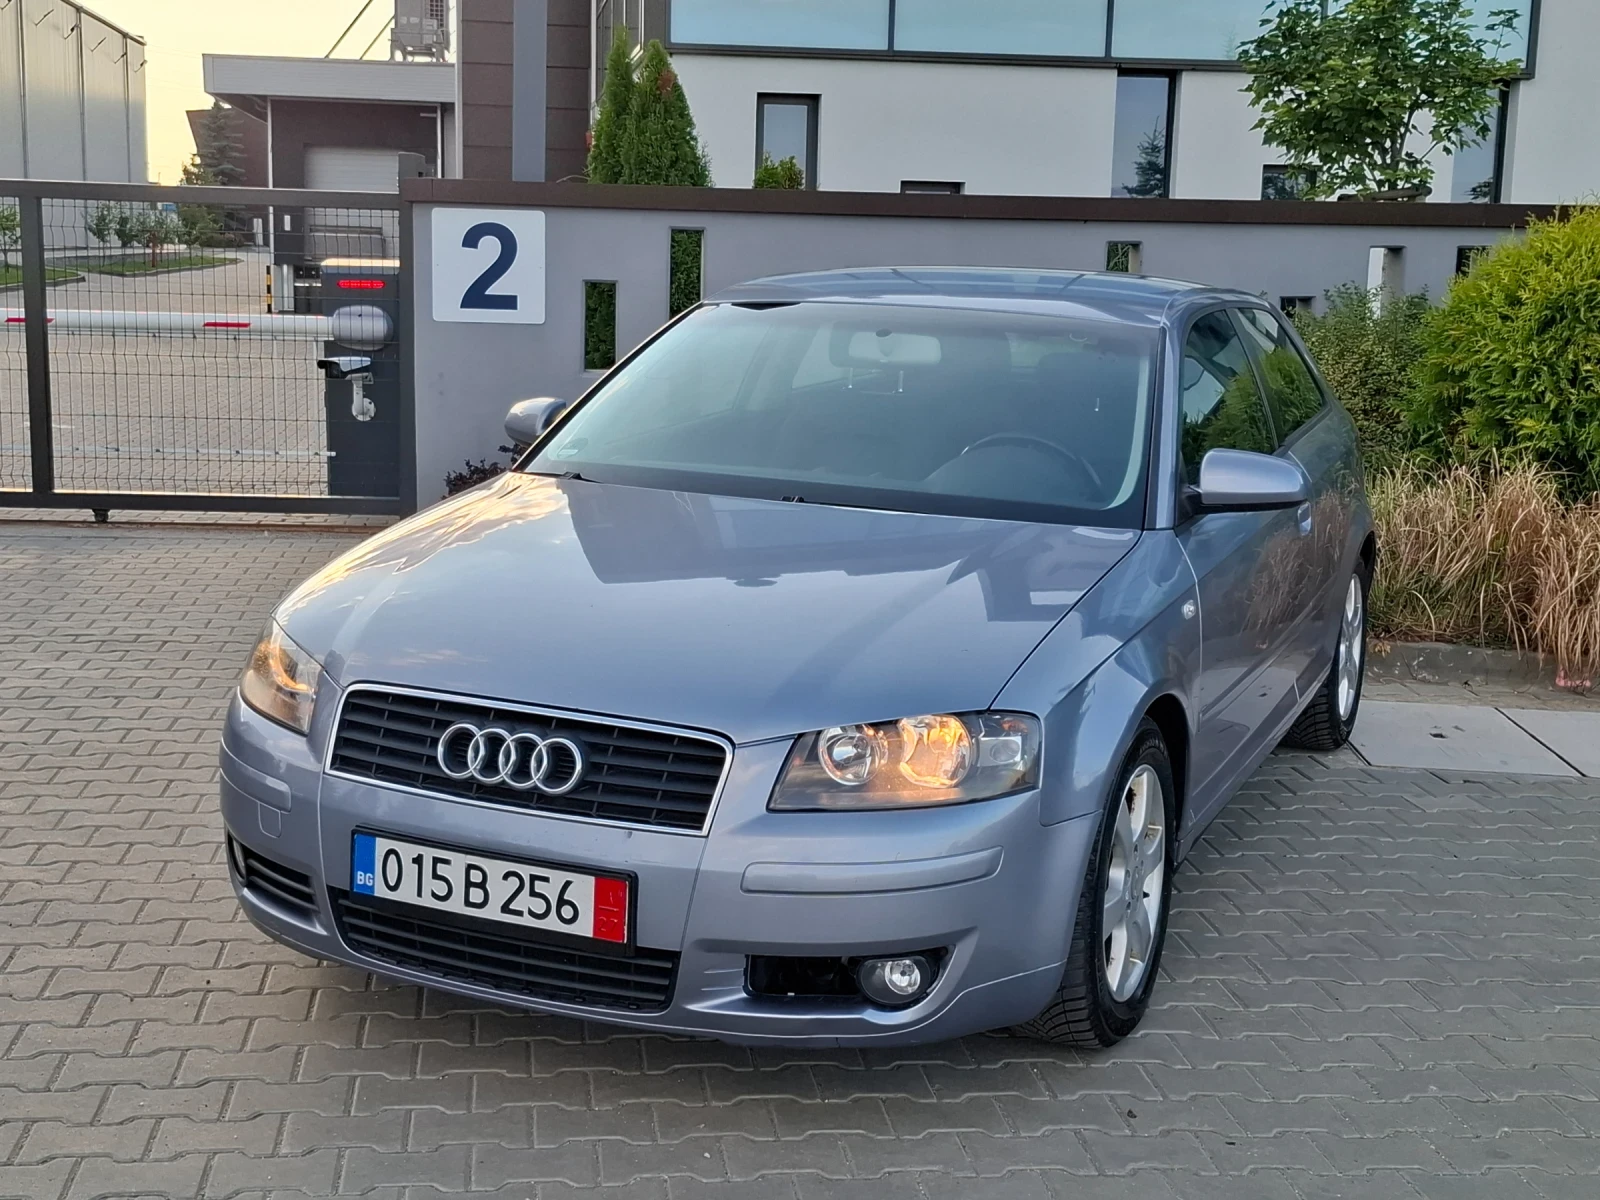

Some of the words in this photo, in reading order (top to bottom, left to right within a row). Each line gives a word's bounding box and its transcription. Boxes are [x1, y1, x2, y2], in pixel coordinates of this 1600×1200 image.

[460, 221, 518, 310] 2
[357, 870, 374, 886] BG
[381, 848, 453, 902] 015
[464, 862, 490, 909] B
[500, 870, 580, 925] 256
